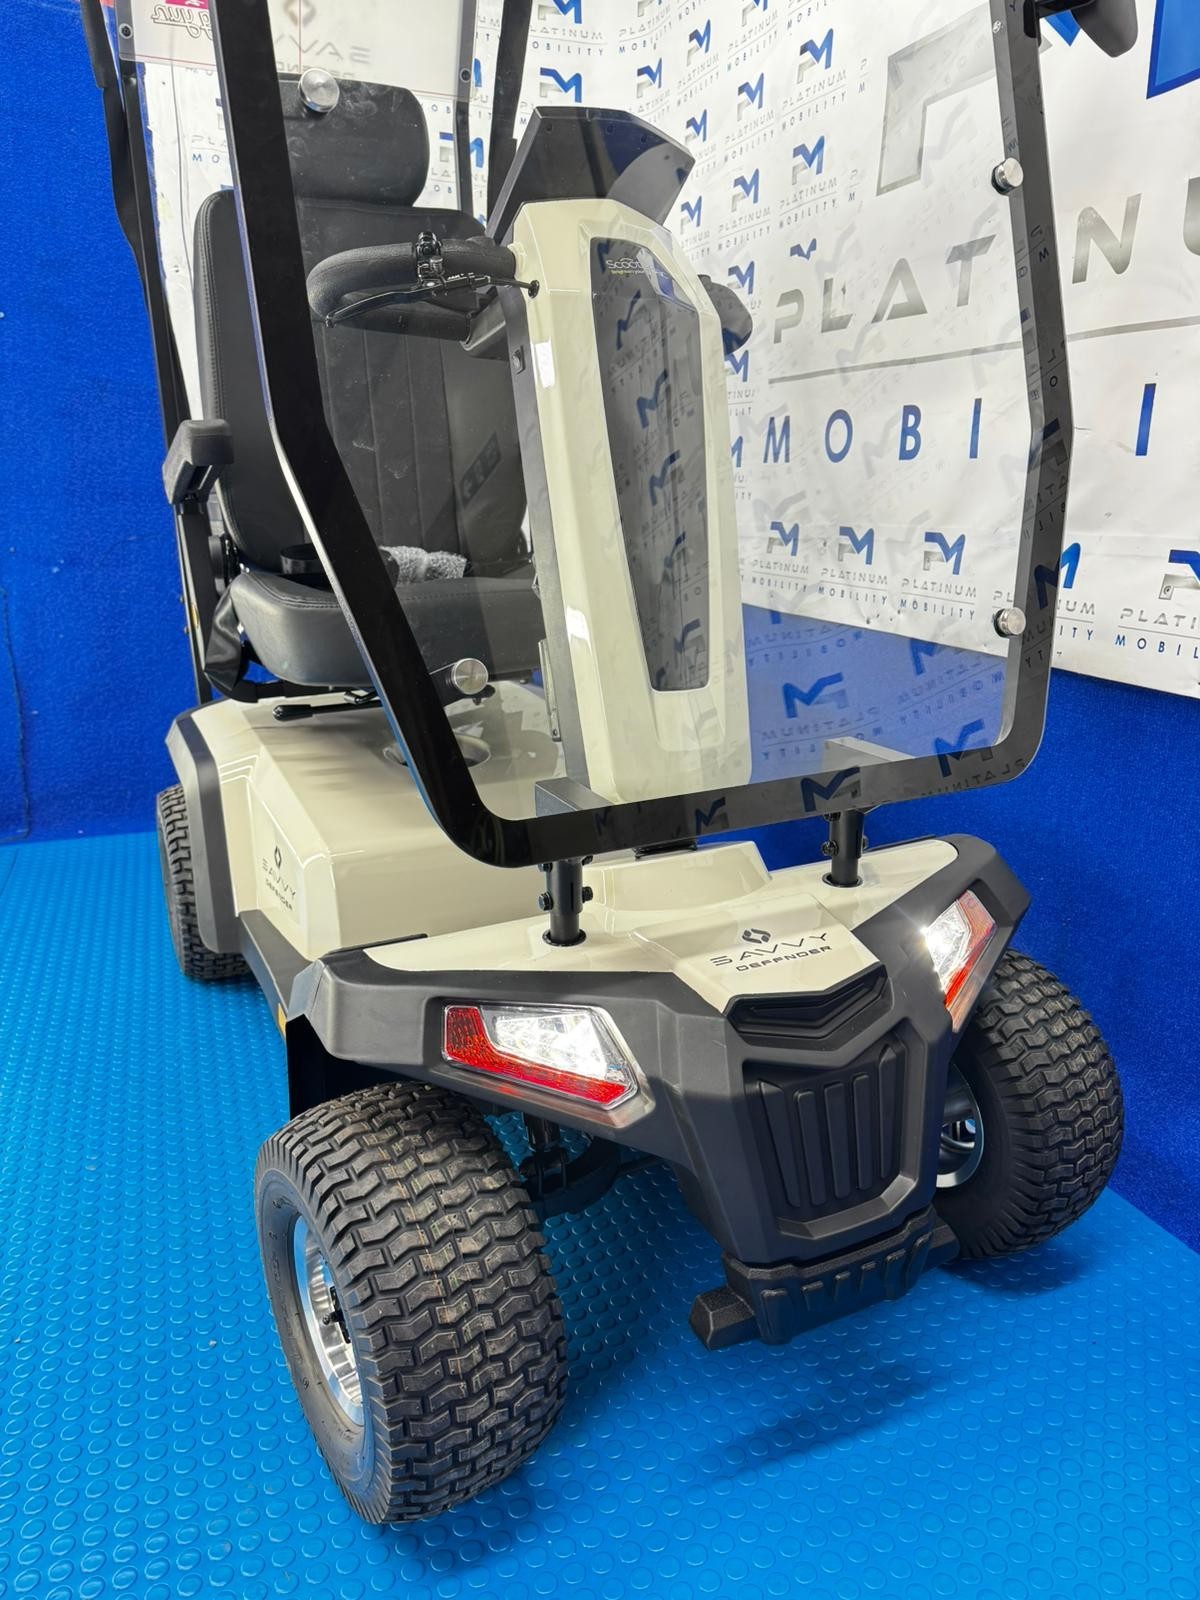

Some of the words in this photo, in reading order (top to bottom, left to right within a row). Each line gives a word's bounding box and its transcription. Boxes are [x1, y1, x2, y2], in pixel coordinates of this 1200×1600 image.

[782, 69, 847, 110] PLATINUM
[782, 91, 846, 131] MOBILITY
[725, 109, 775, 146] PLATINUM
[724, 129, 774, 164] MOBILITY
[779, 177, 838, 209] PLATINUM
[718, 207, 771, 235] PLATINUM
[779, 198, 838, 230] MOBILITY
[718, 227, 771, 251] MOBILITY
[752, 559, 810, 575] PLATINUM
[821, 568, 889, 585] PLATINUM
[752, 576, 808, 593] MOBILITY
[818, 586, 888, 606] MOBILITY
[901, 578, 977, 598] PLATINUM
[900, 599, 976, 621] MOBILITY
[710, 932, 828, 967] SAVVY
